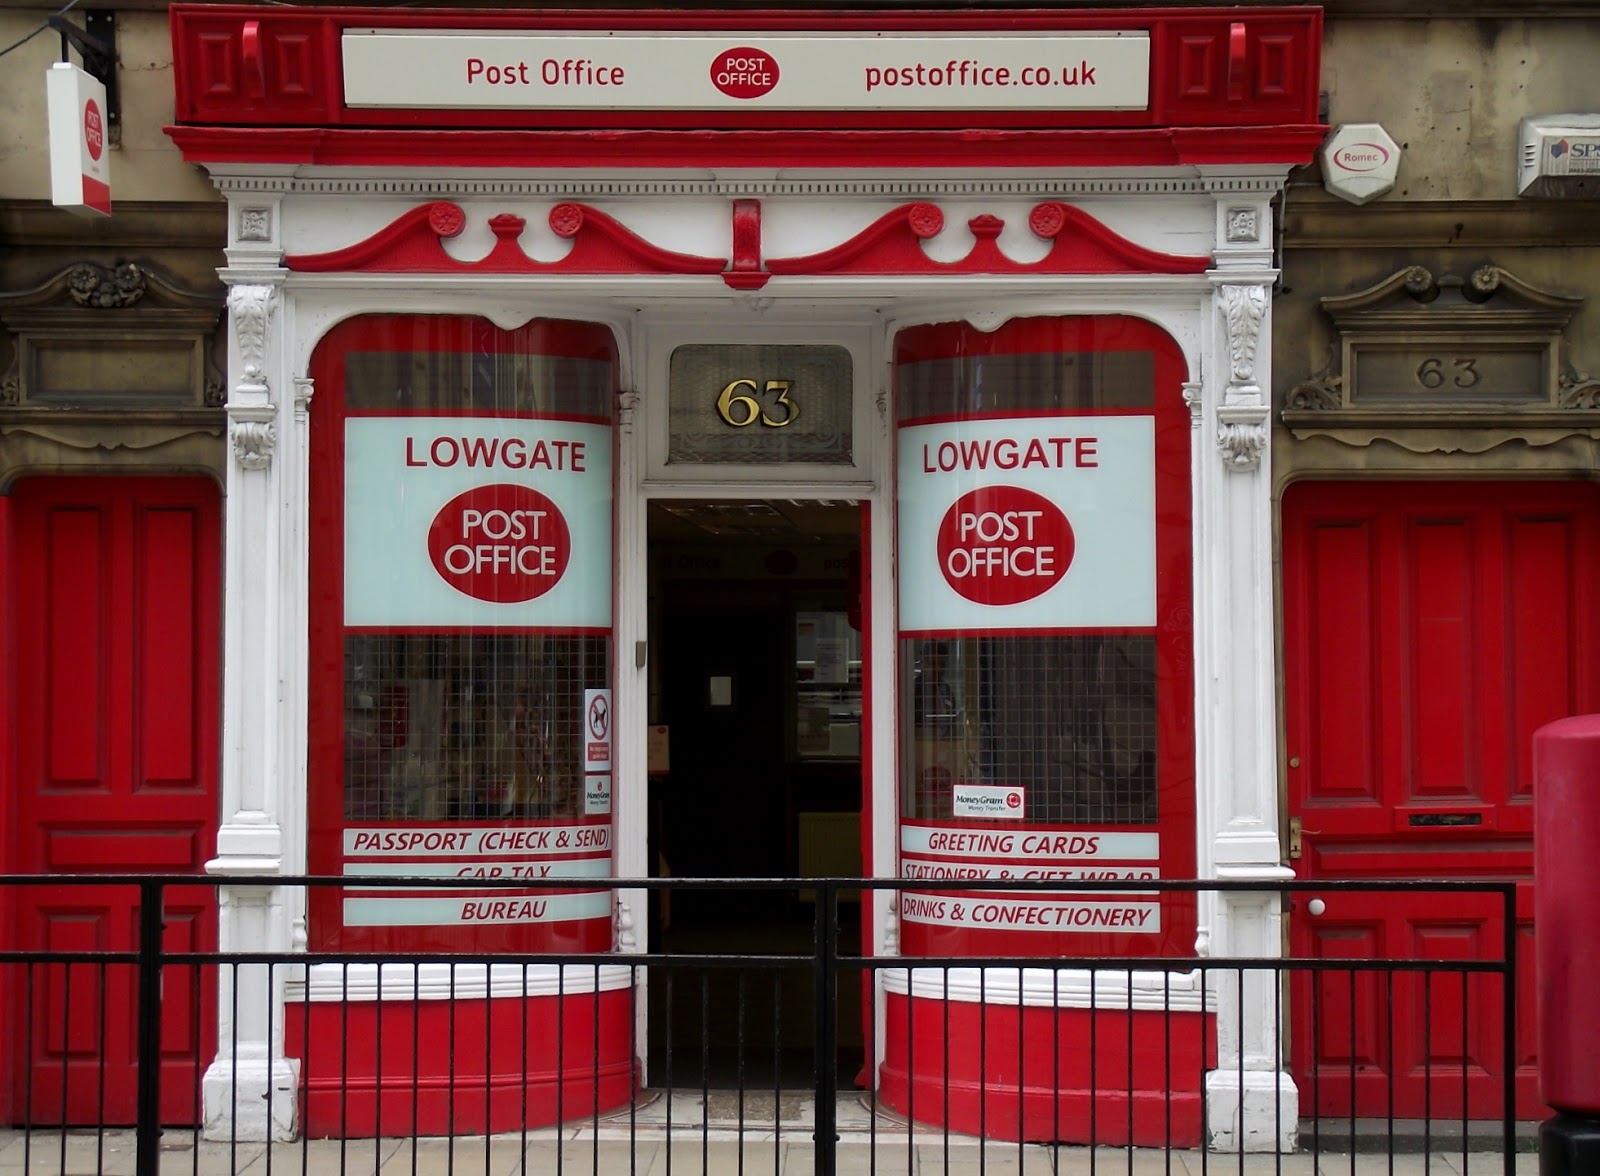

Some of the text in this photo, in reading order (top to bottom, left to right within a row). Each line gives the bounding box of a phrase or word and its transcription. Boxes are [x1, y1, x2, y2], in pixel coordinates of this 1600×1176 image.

[467, 58, 625, 85] Post Office
[726, 58, 766, 71] POST
[865, 60, 1097, 92] postoffice.co.uk
[717, 72, 772, 86] OFFICE
[87, 110, 99, 129] POST
[87, 127, 102, 147] OFFICE
[1344, 153, 1378, 162] Romec
[1416, 358, 1482, 388] 63
[715, 379, 800, 427] 63
[405, 436, 586, 472] LOWGATE
[923, 437, 1099, 473] LOWGATE
[463, 509, 547, 540] POST
[960, 511, 1043, 542] POST
[444, 544, 556, 575] OFFICE
[947, 546, 1055, 578] OFFICE
[955, 795, 1003, 805] MoneyGram
[353, 828, 609, 853] PASSPORT (CHECK & SEND)
[928, 832, 1100, 855] GREETING CARDS
[511, 865, 552, 878] TAX
[461, 900, 547, 920] BUREAU
[903, 898, 1153, 926] DRINKS & CONFECTIONERY
